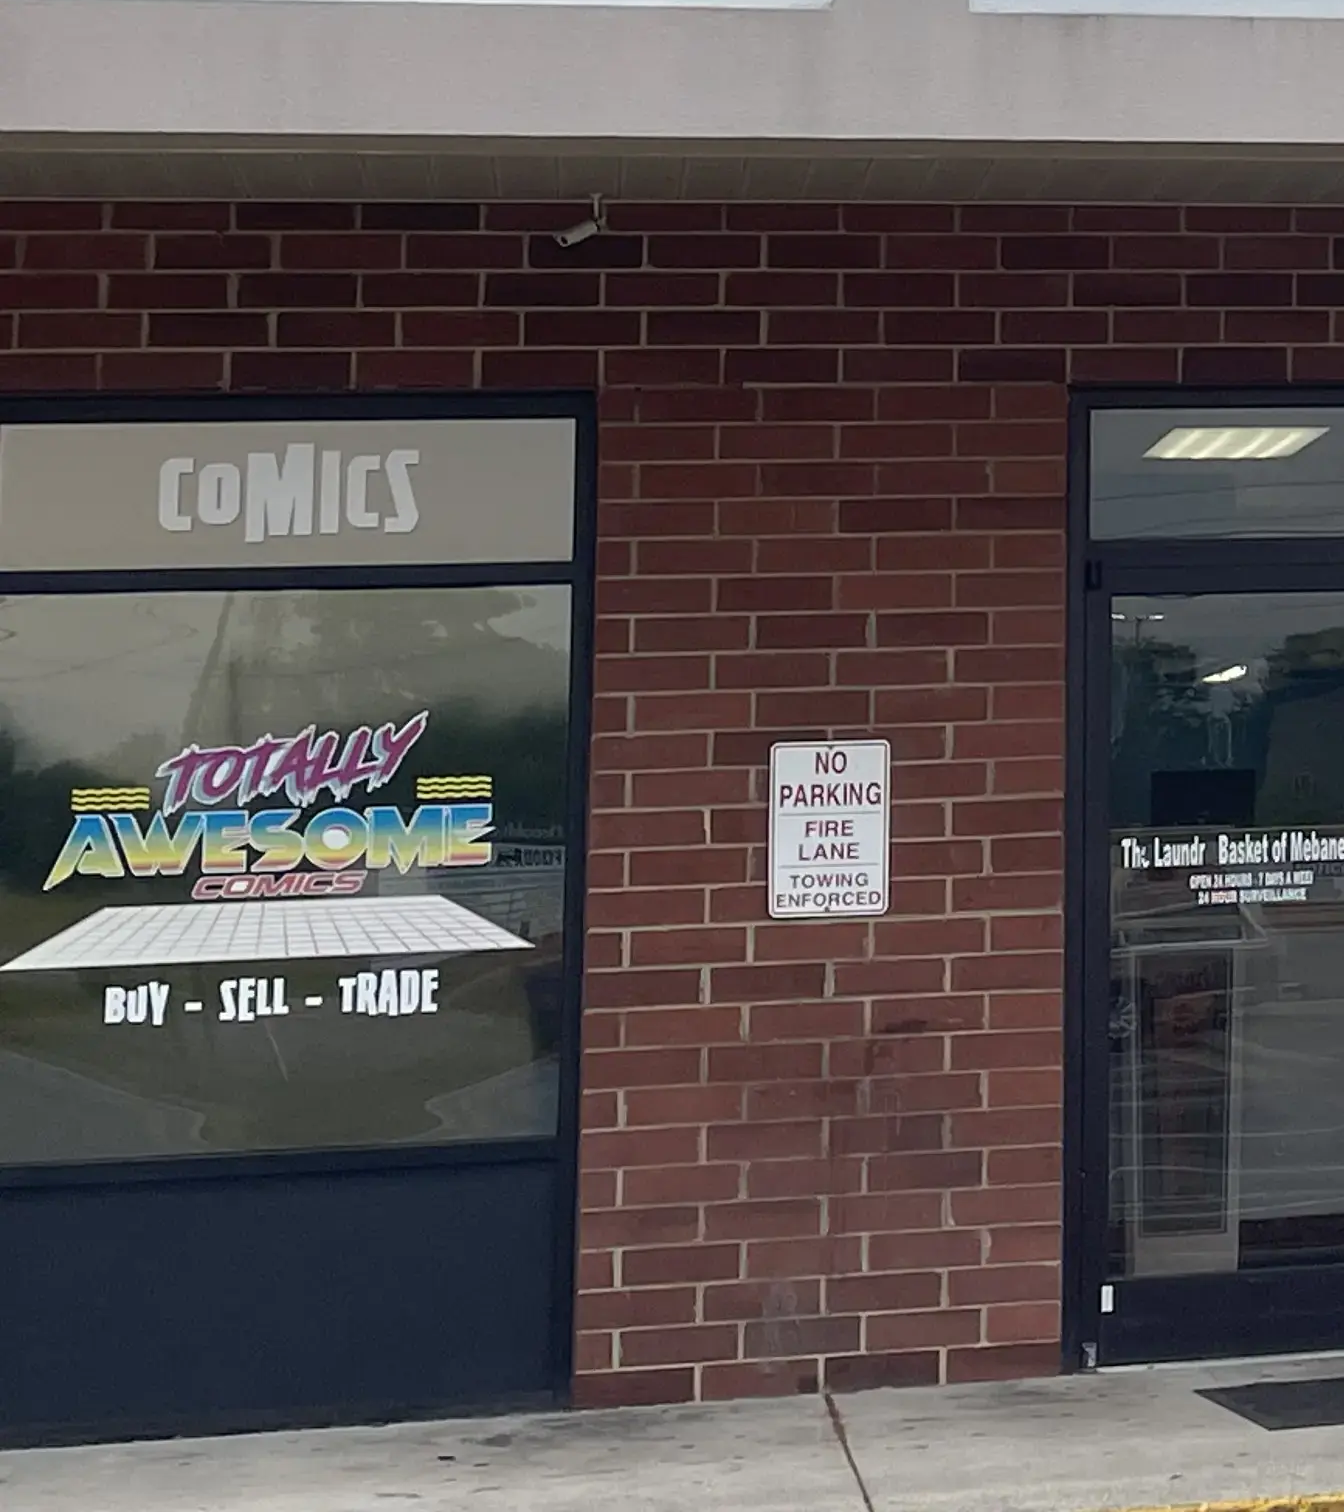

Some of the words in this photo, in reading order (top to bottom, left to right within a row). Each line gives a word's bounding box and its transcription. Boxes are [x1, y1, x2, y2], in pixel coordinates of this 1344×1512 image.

[155, 710, 429, 816] TOTALLY
[815, 751, 847, 774] NO
[780, 782, 881, 808] PARKING
[805, 820, 854, 838] FIRE
[43, 803, 497, 892] AWESOME
[799, 843, 860, 861] LANE
[1218, 833, 1269, 864] Basket
[1272, 831, 1288, 863] of
[191, 870, 368, 900] COMICS
[789, 872, 869, 889] TOWING
[776, 891, 881, 908] ENFORCED
[1211, 890, 1237, 903] HOUR
[104, 982, 169, 1026] BUY
[219, 977, 290, 1022] SELL
[338, 969, 439, 1017] TRADE
